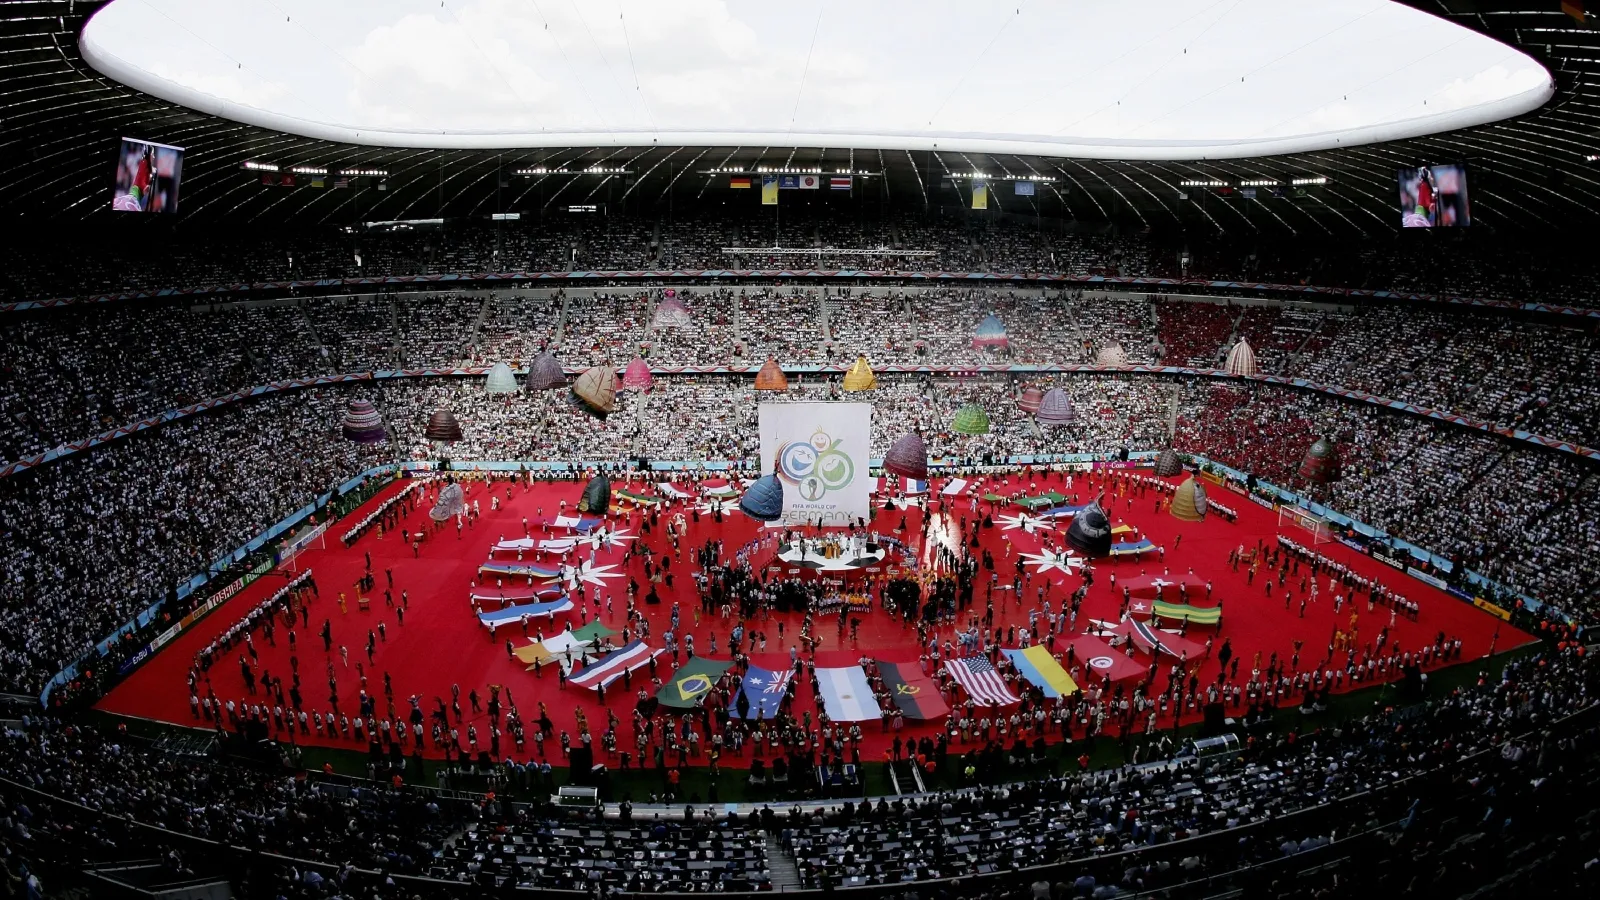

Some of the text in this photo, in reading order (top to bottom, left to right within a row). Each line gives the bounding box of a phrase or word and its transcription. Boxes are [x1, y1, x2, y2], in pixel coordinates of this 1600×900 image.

[781, 510, 854, 520] GERMANY
[1384, 556, 1403, 570] adidas
[209, 579, 243, 606] TOSHIBA
